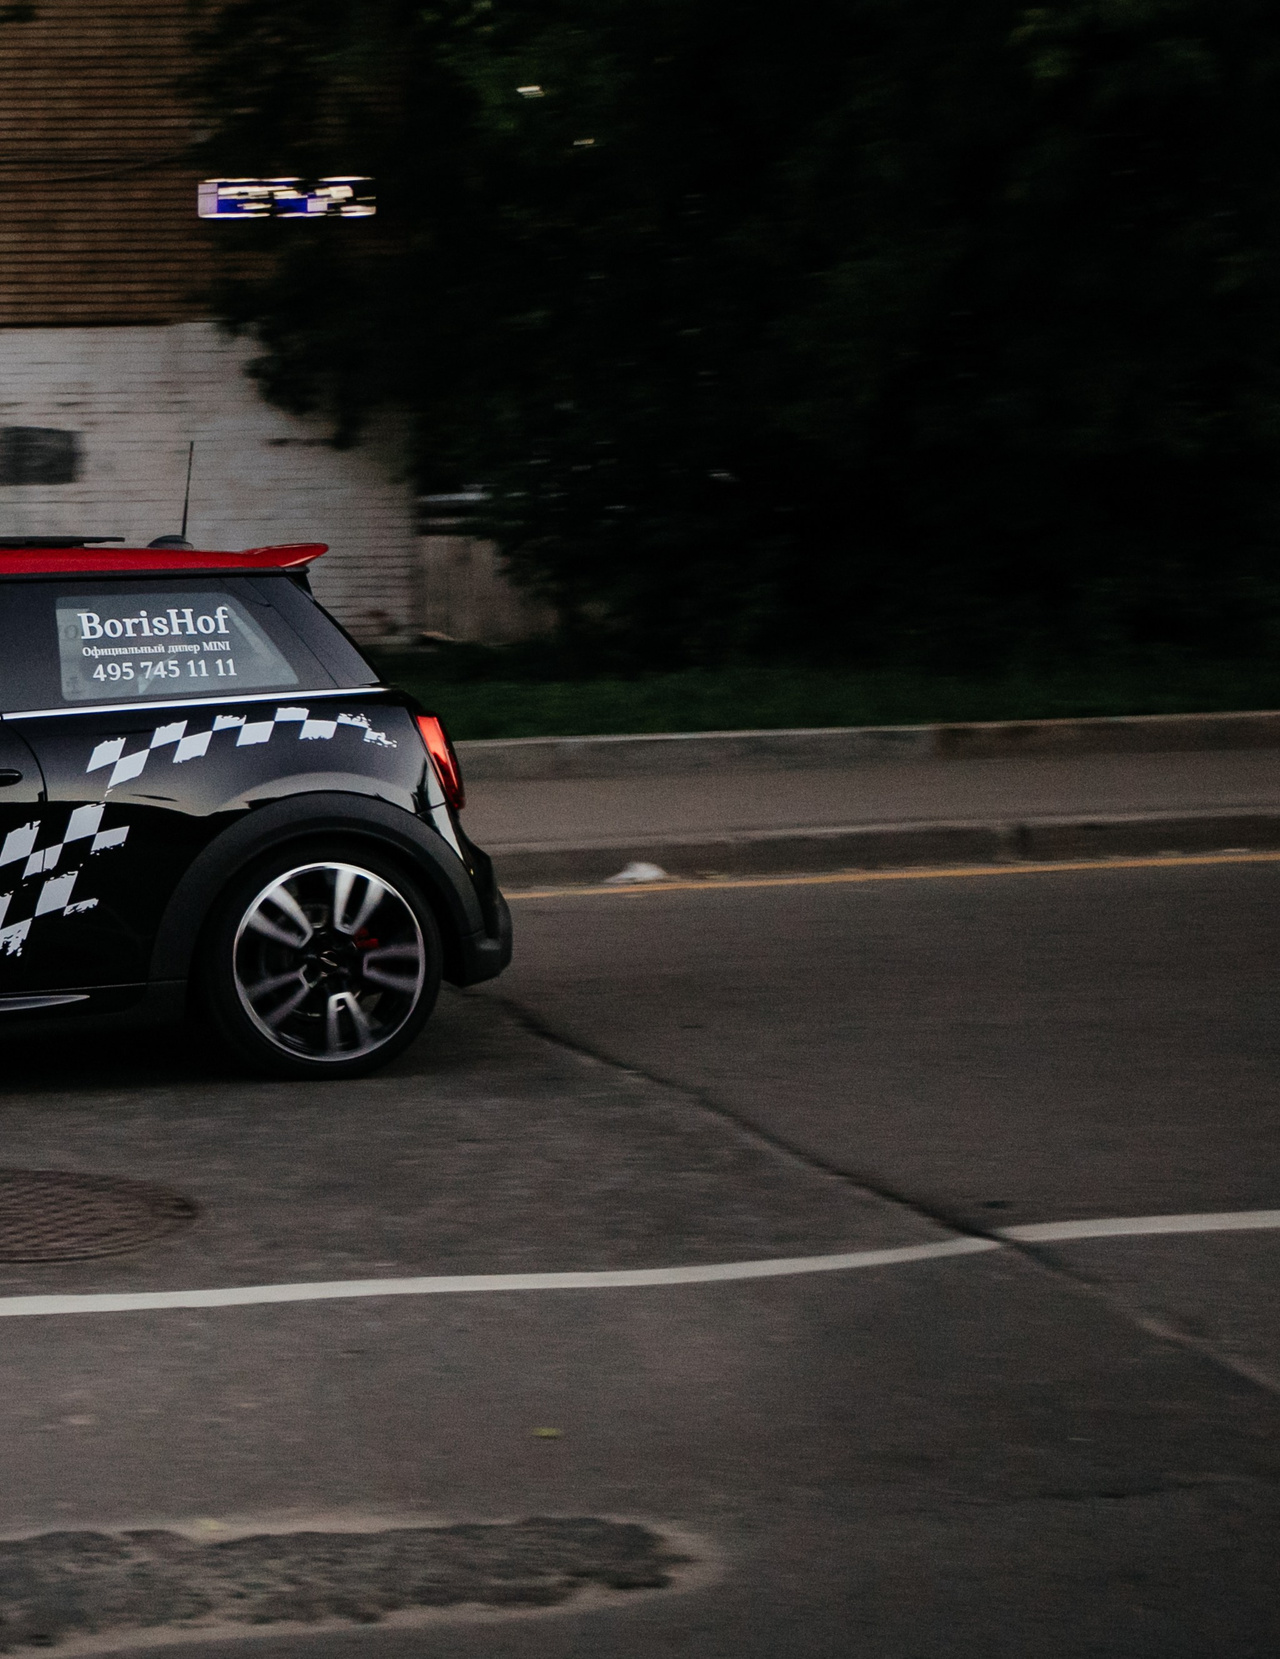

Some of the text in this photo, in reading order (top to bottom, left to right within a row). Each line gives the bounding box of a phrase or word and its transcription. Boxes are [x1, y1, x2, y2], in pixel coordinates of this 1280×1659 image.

[77, 607, 229, 639] BorisHof
[82, 641, 231, 657] Официальный дилер MINI
[92, 658, 237, 681] 495 745 11 11
